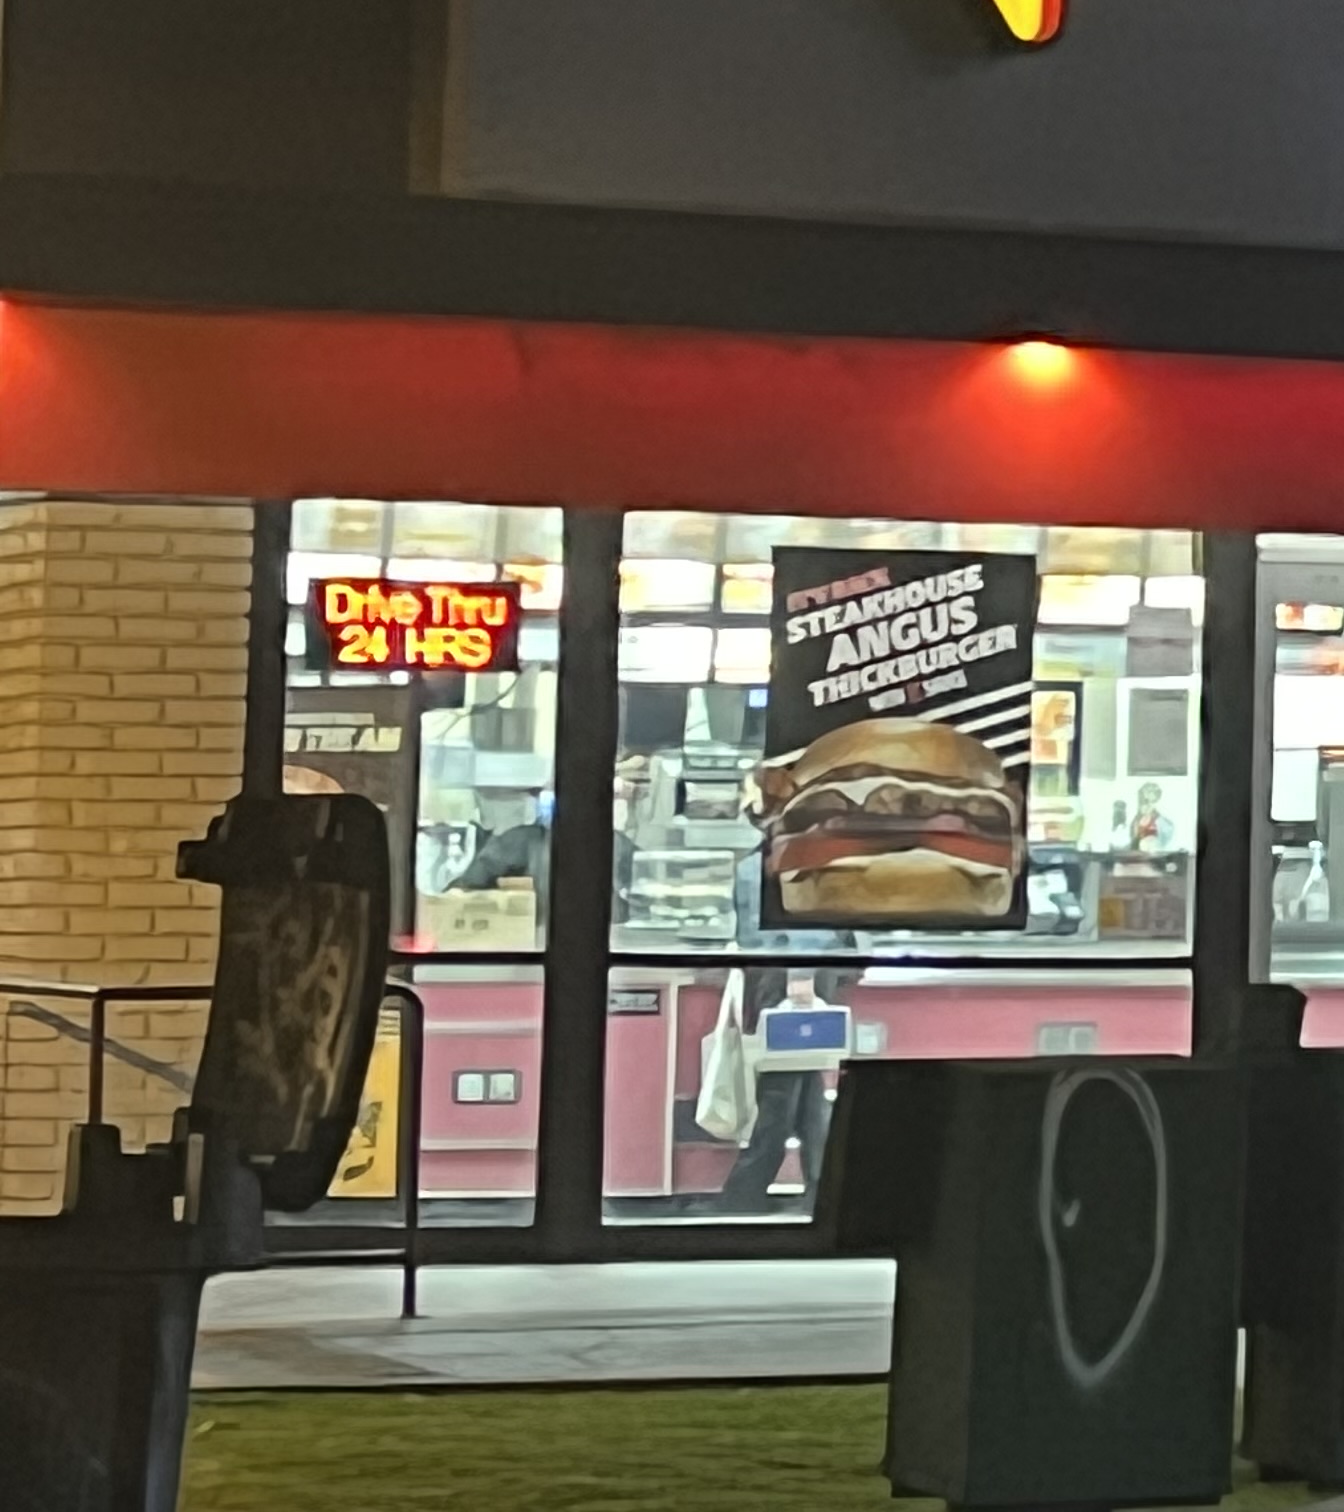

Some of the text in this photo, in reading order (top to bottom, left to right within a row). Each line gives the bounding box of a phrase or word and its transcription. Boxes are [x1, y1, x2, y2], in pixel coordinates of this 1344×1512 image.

[325, 583, 508, 627] Drive Thru
[785, 563, 985, 645] STEAKHOUSE
[825, 595, 978, 673] ANGUS
[337, 624, 493, 668] 24 HRS
[806, 623, 1018, 707] THICKBURGER
